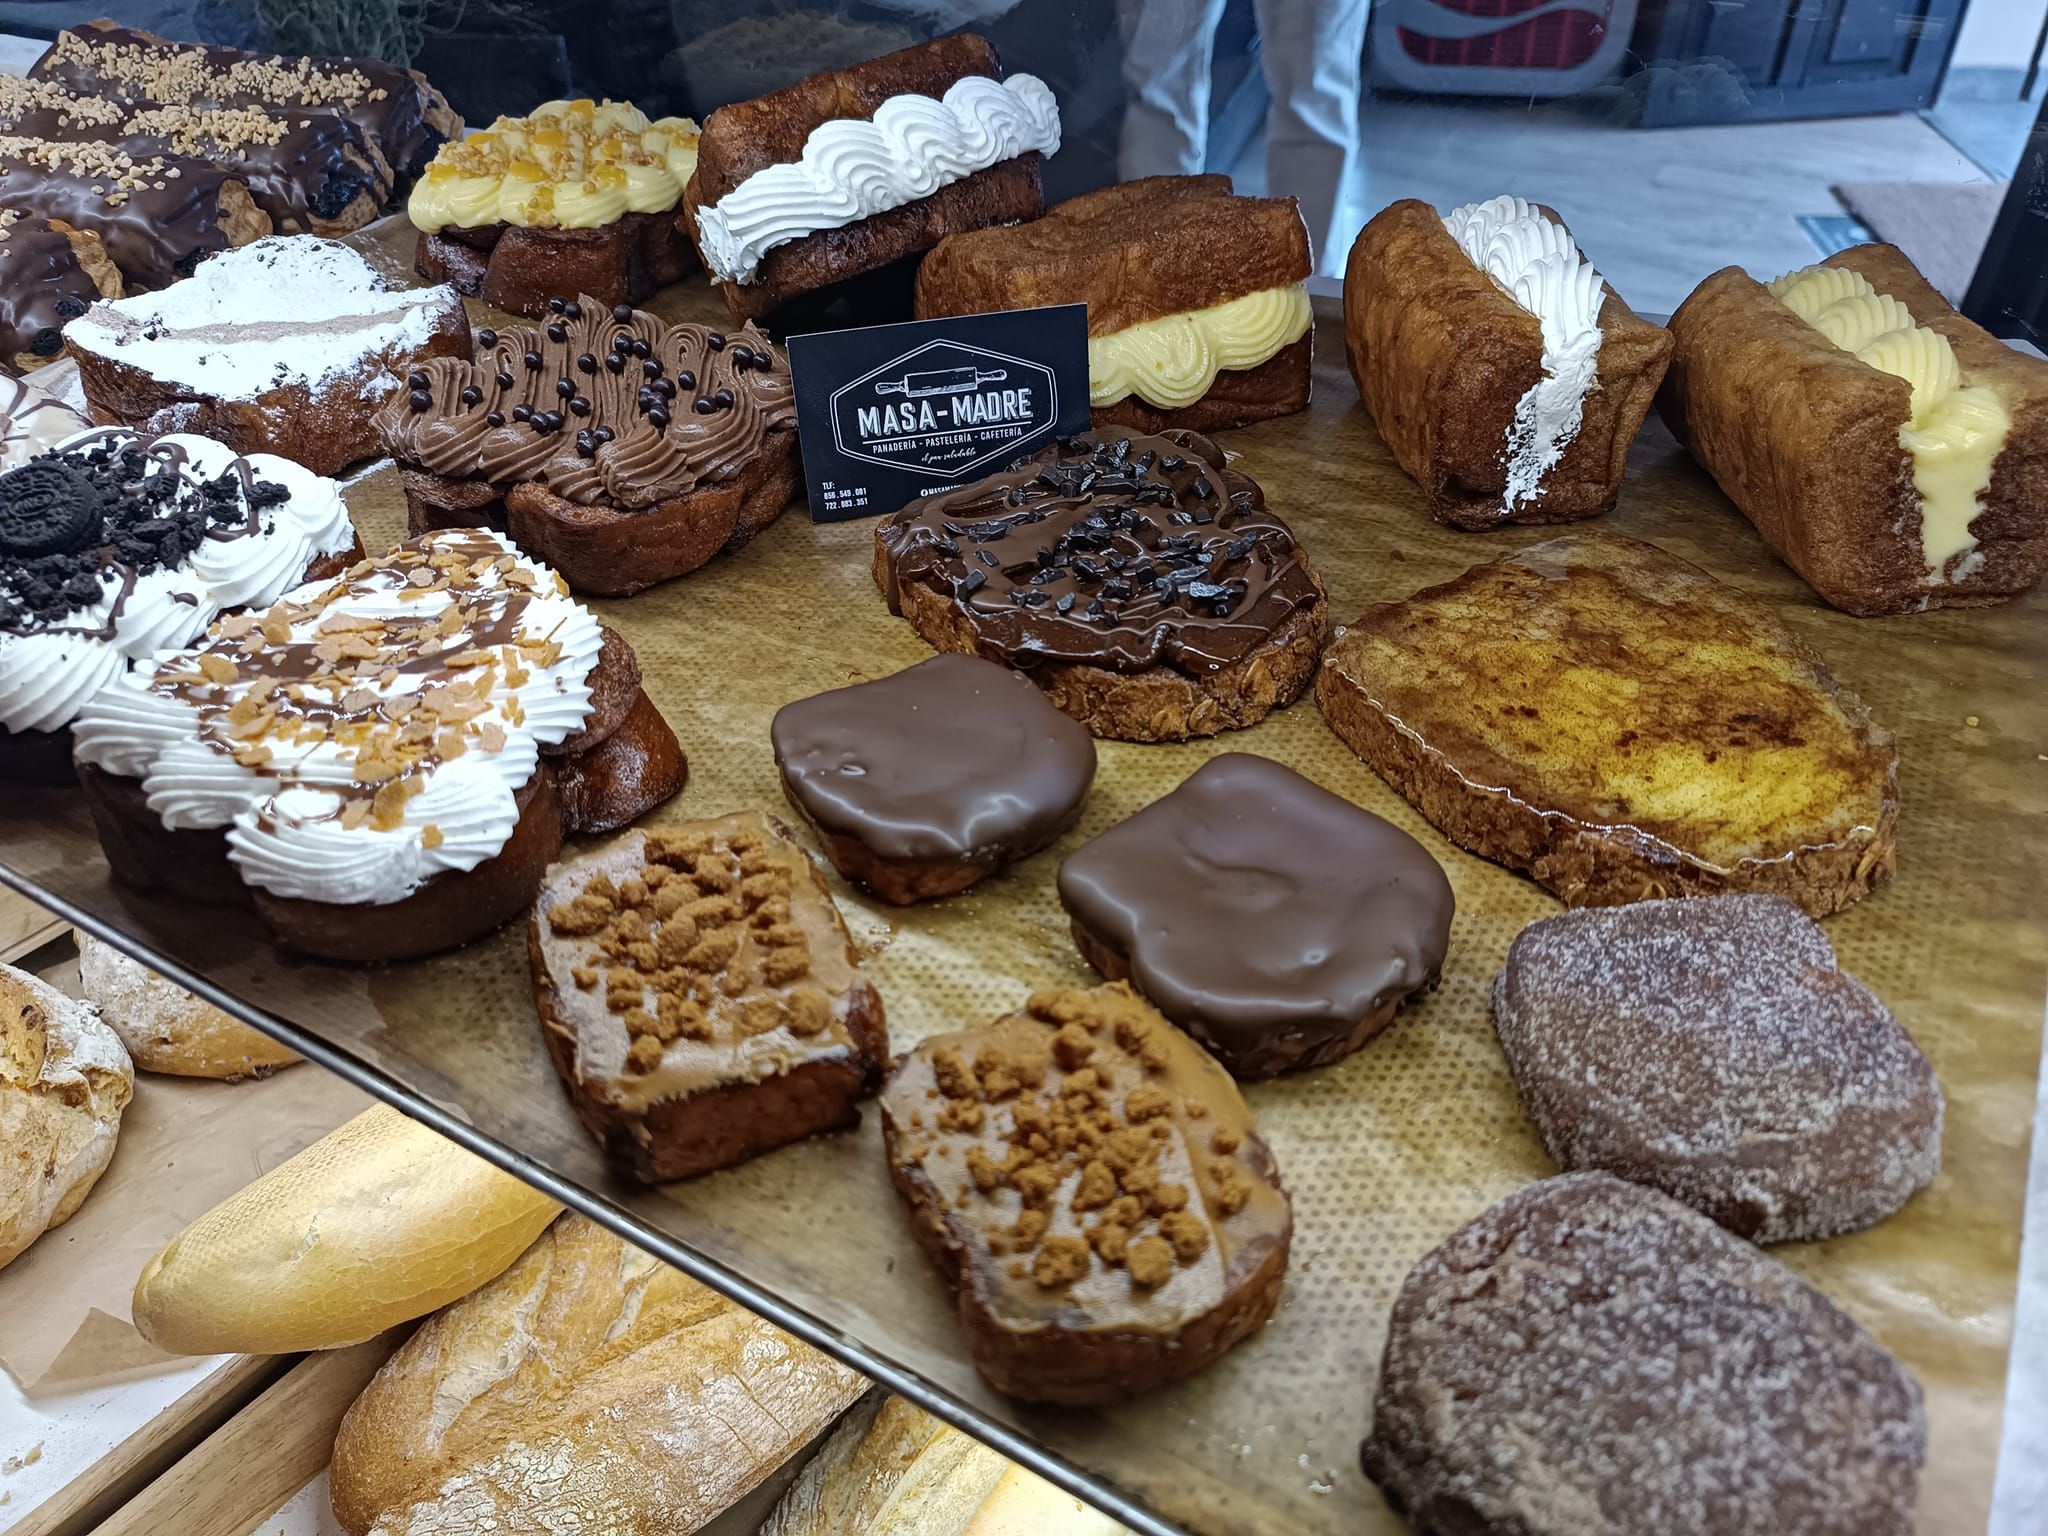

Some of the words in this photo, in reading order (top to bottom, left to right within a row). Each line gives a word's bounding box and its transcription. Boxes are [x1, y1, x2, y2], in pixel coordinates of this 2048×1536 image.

[857, 387, 1034, 438] MASA-MADRE
[872, 440, 918, 455] PANADERÍA
[925, 432, 972, 447] PASTELERÍA
[980, 426, 1023, 441] CAFETERÍA
